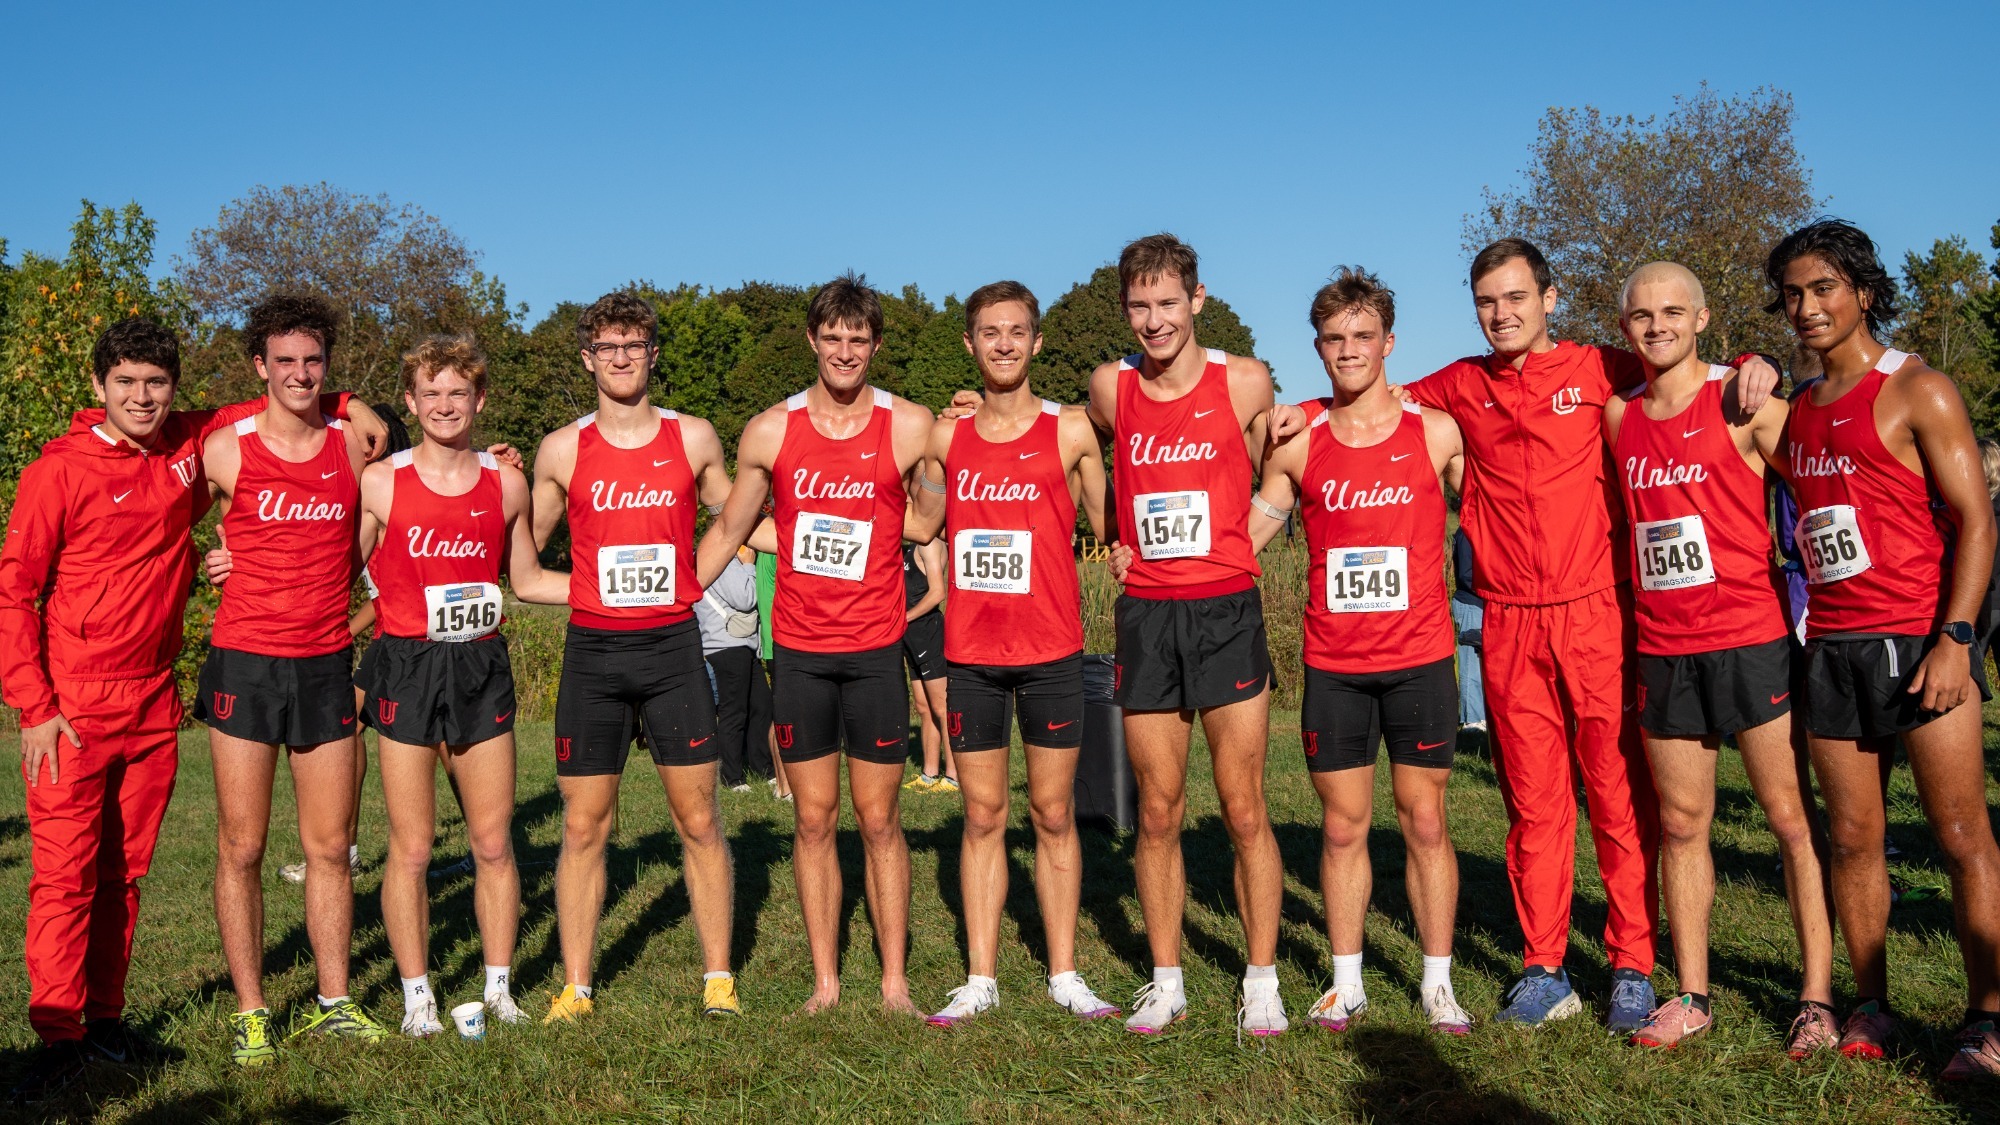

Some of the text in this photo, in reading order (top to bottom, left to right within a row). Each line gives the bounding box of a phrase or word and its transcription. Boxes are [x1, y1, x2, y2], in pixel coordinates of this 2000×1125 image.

[1552, 387, 1582, 416] U
[1130, 433, 1218, 466] Union
[1790, 441, 1857, 478] Union
[171, 453, 197, 489] U
[794, 468, 875, 499] Union
[958, 469, 1041, 502] Union
[1627, 456, 1708, 490] Union
[257, 489, 346, 522] Union
[591, 480, 677, 512] Union
[1322, 479, 1414, 512] Union
[408, 525, 487, 559] Union
[1141, 515, 1203, 546] 1547
[800, 534, 862, 567] 1557
[1151, 547, 1196, 556] #SWAGSXCC
[1643, 541, 1704, 577] 1548
[1802, 529, 1857, 569] 1556
[606, 566, 669, 594] 1552
[806, 564, 849, 577] #SWAGSXCC
[962, 551, 1024, 580] 1558
[970, 582, 1013, 590] #SWAGSXCC
[1334, 569, 1401, 599] 1549
[1653, 576, 1697, 588] #SWAGSXCC
[435, 602, 496, 633] 1546
[1343, 602, 1391, 610] #SWAGSXCC
[443, 631, 485, 641] #SWAGSXCC
[213, 691, 237, 720] U
[378, 697, 399, 725] U
[774, 724, 793, 749] U
[947, 711, 963, 737] U
[555, 737, 572, 761] U
[1301, 731, 1319, 757] U
